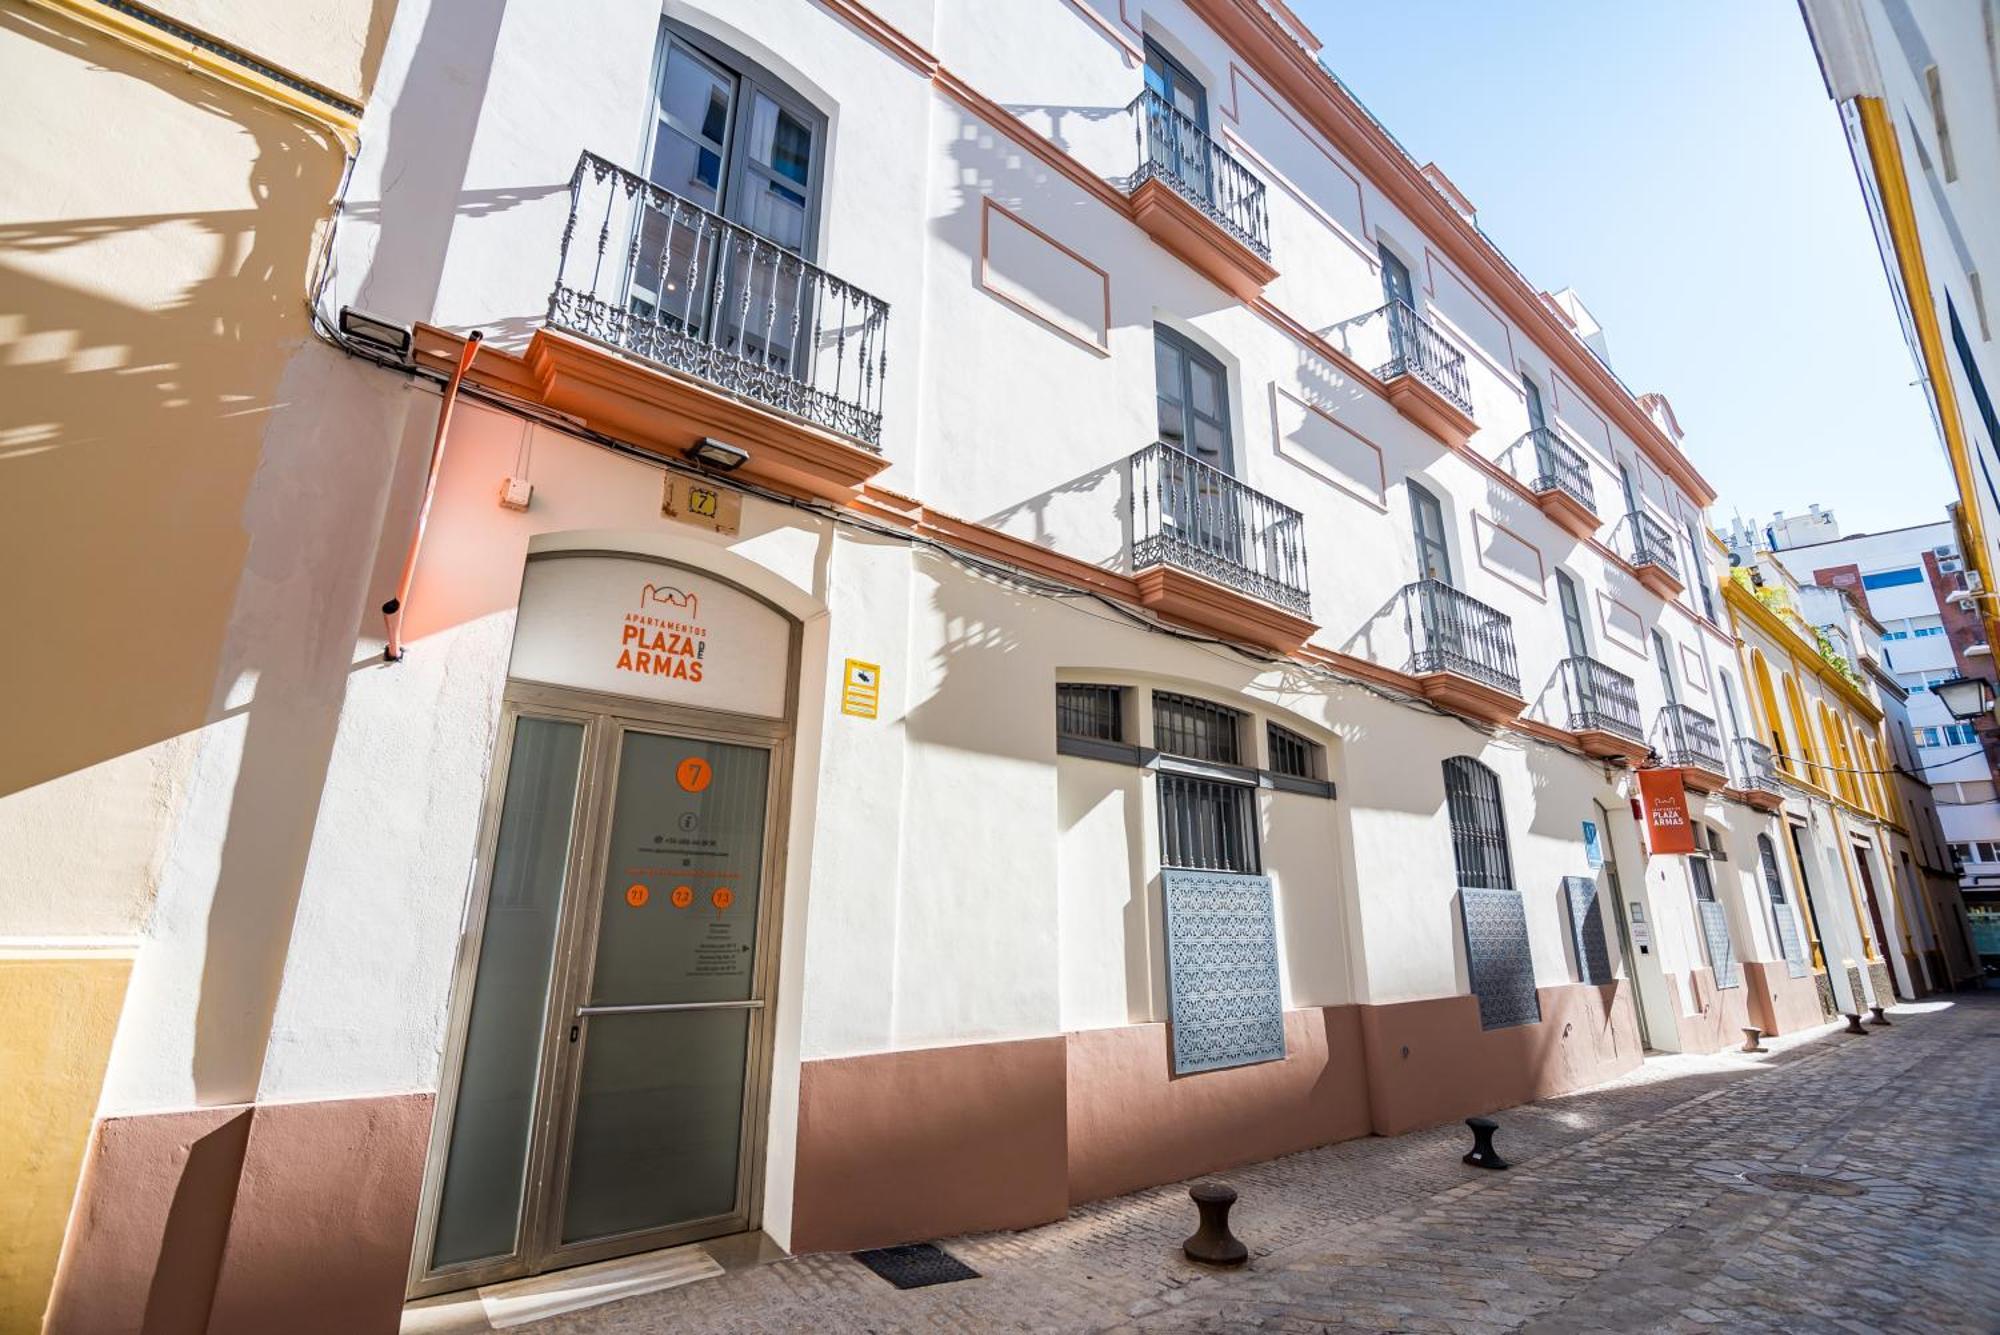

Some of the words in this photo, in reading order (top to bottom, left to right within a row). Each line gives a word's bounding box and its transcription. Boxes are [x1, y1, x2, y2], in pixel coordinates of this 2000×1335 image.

[699, 495, 708, 508] 7
[624, 613, 706, 636] APARTAMENTOS
[622, 624, 694, 658] PLAZA
[696, 640, 705, 660] DE
[616, 648, 702, 683] ARMAS
[688, 764, 701, 786] 7
